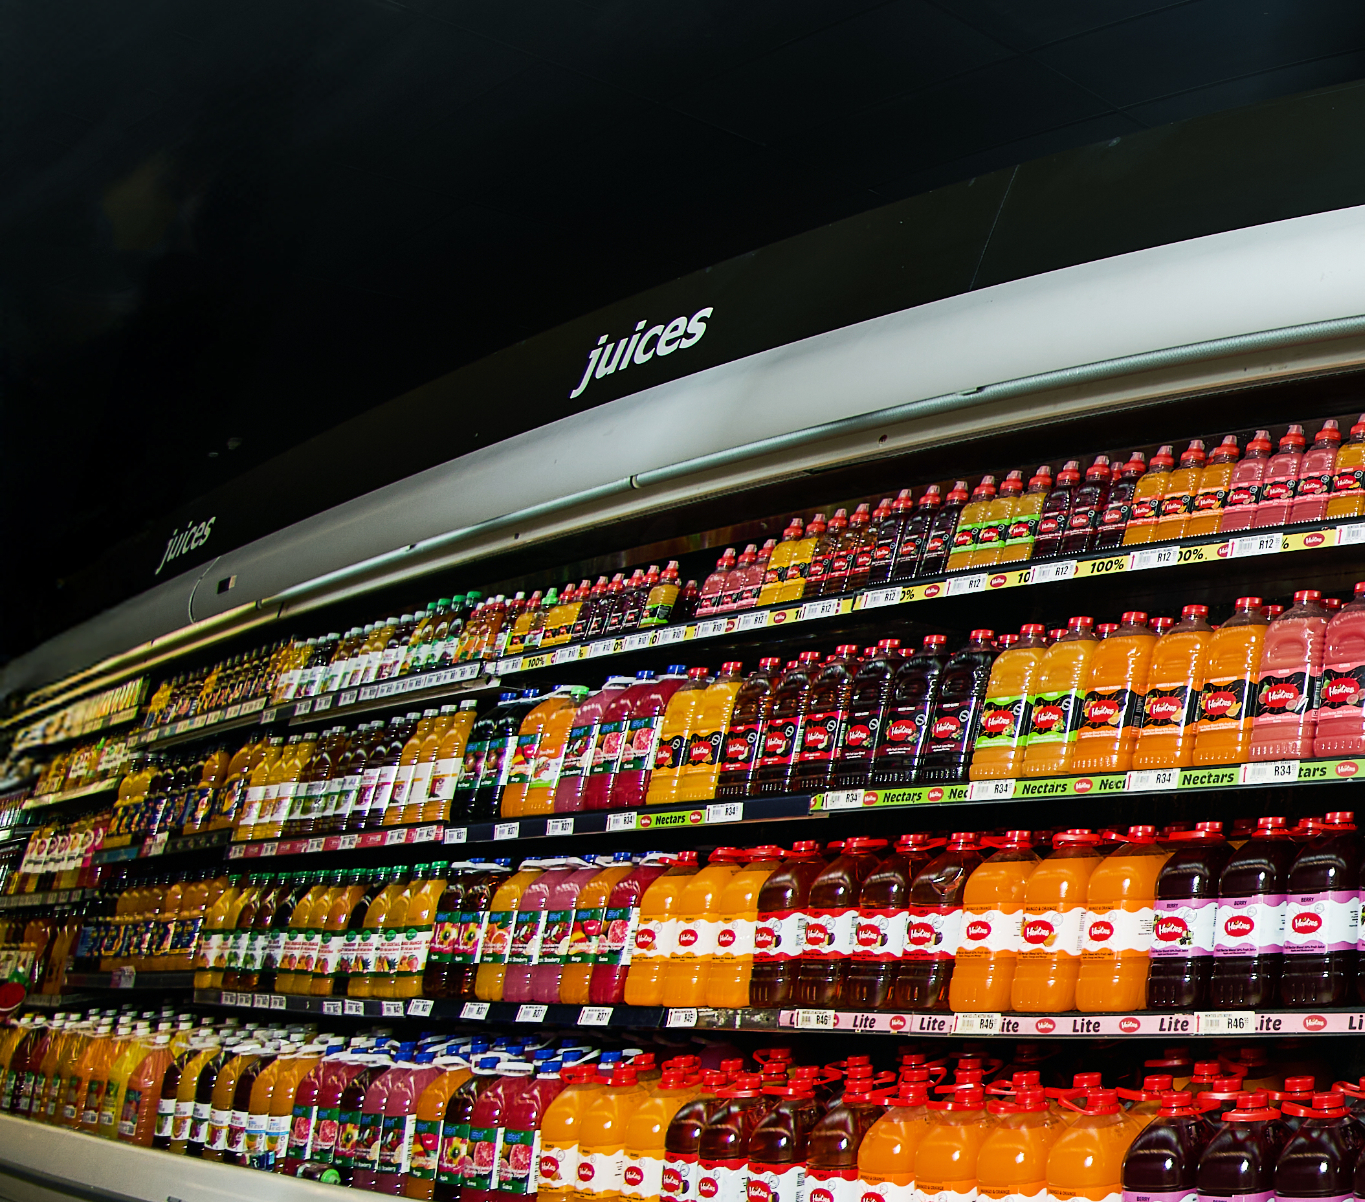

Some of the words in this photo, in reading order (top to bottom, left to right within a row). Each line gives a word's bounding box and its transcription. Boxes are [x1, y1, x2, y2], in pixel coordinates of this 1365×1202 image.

[570, 307, 713, 399] juices
[155, 517, 216, 575] juices
[1090, 559, 1124, 574] 100%
[1328, 683, 1355, 695] Henties
[1267, 691, 1294, 702] Henties
[1153, 702, 1177, 714] Henties
[1181, 771, 1234, 786] Nectars
[1022, 782, 1068, 795] Nectars
[883, 791, 922, 803] Nectars
[919, 1017, 946, 1031] Lite
[1072, 1018, 1101, 1033] Lite
[1158, 1017, 1189, 1032] Lite
